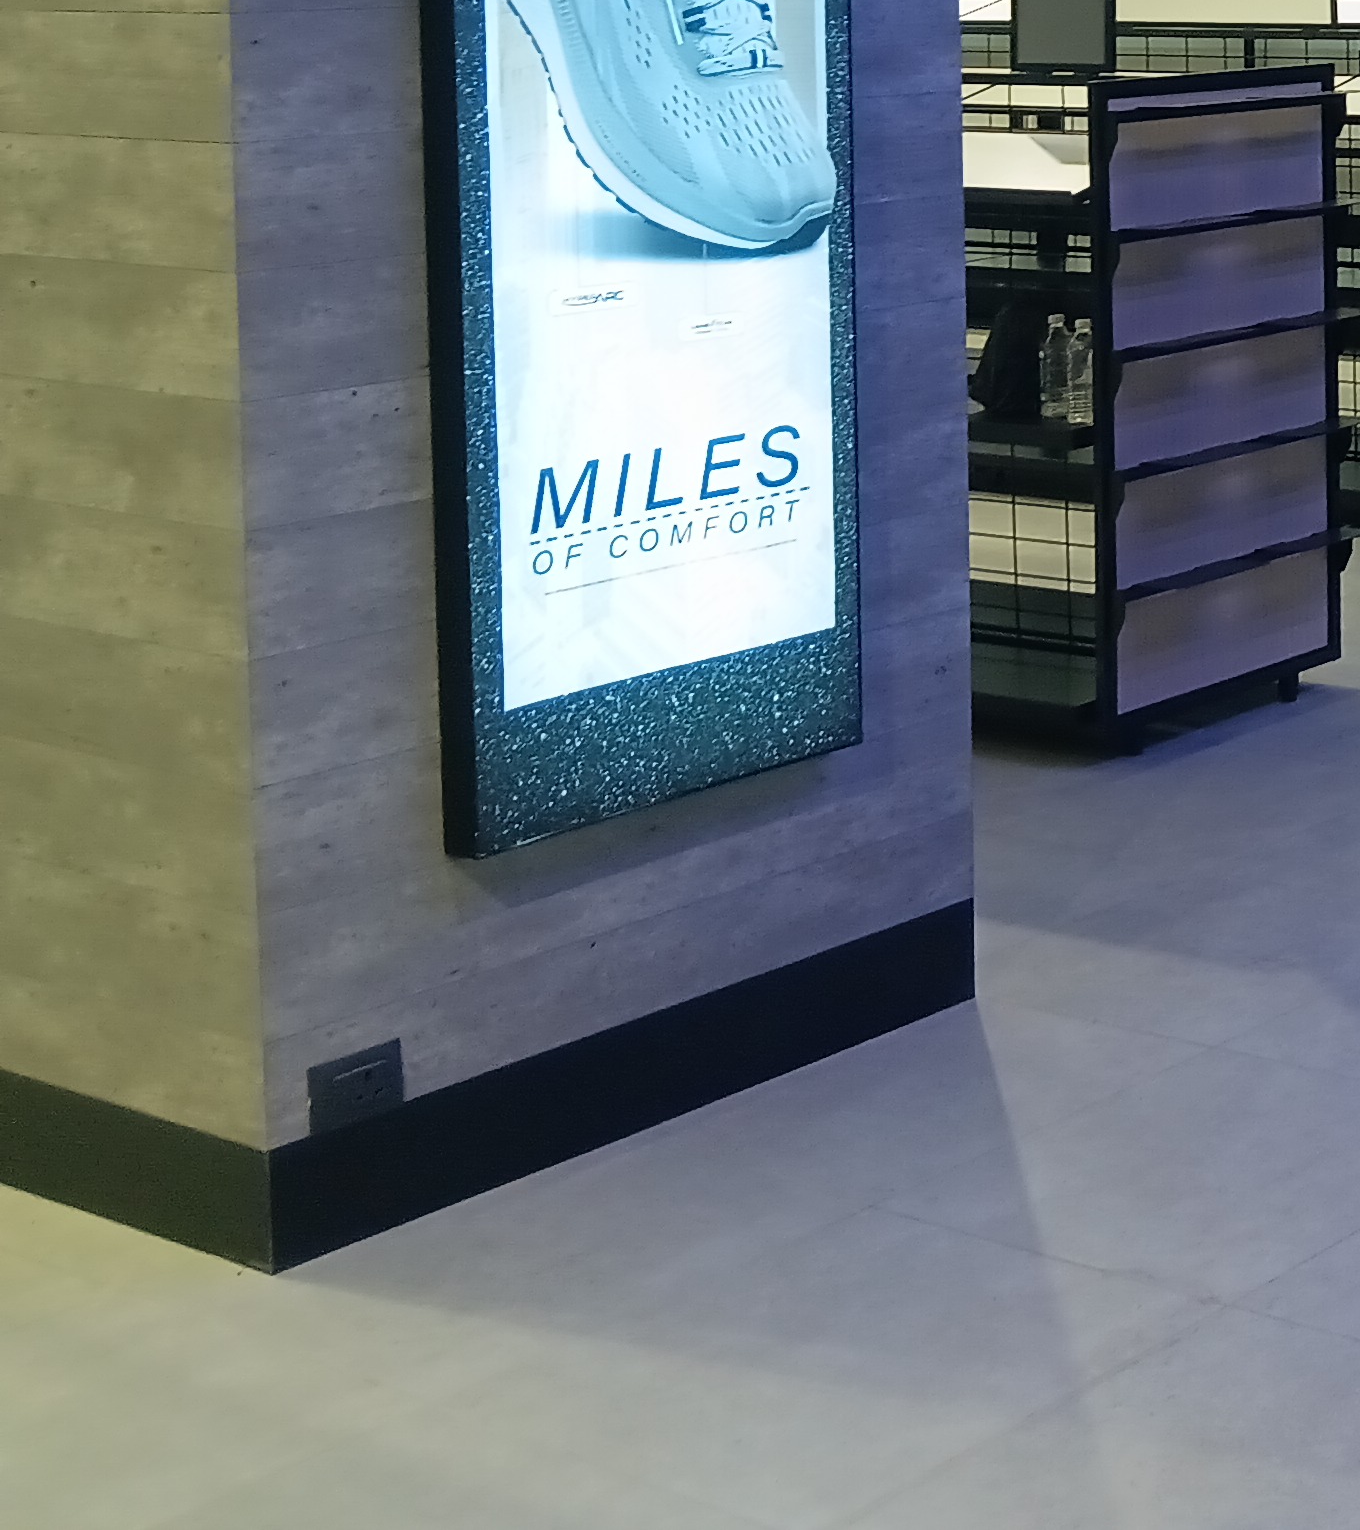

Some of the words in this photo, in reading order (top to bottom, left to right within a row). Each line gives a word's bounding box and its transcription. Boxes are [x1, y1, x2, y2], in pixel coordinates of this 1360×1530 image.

[530, 425, 802, 534] MILES
[532, 544, 582, 575] OF
[608, 500, 801, 559] COMFORT
